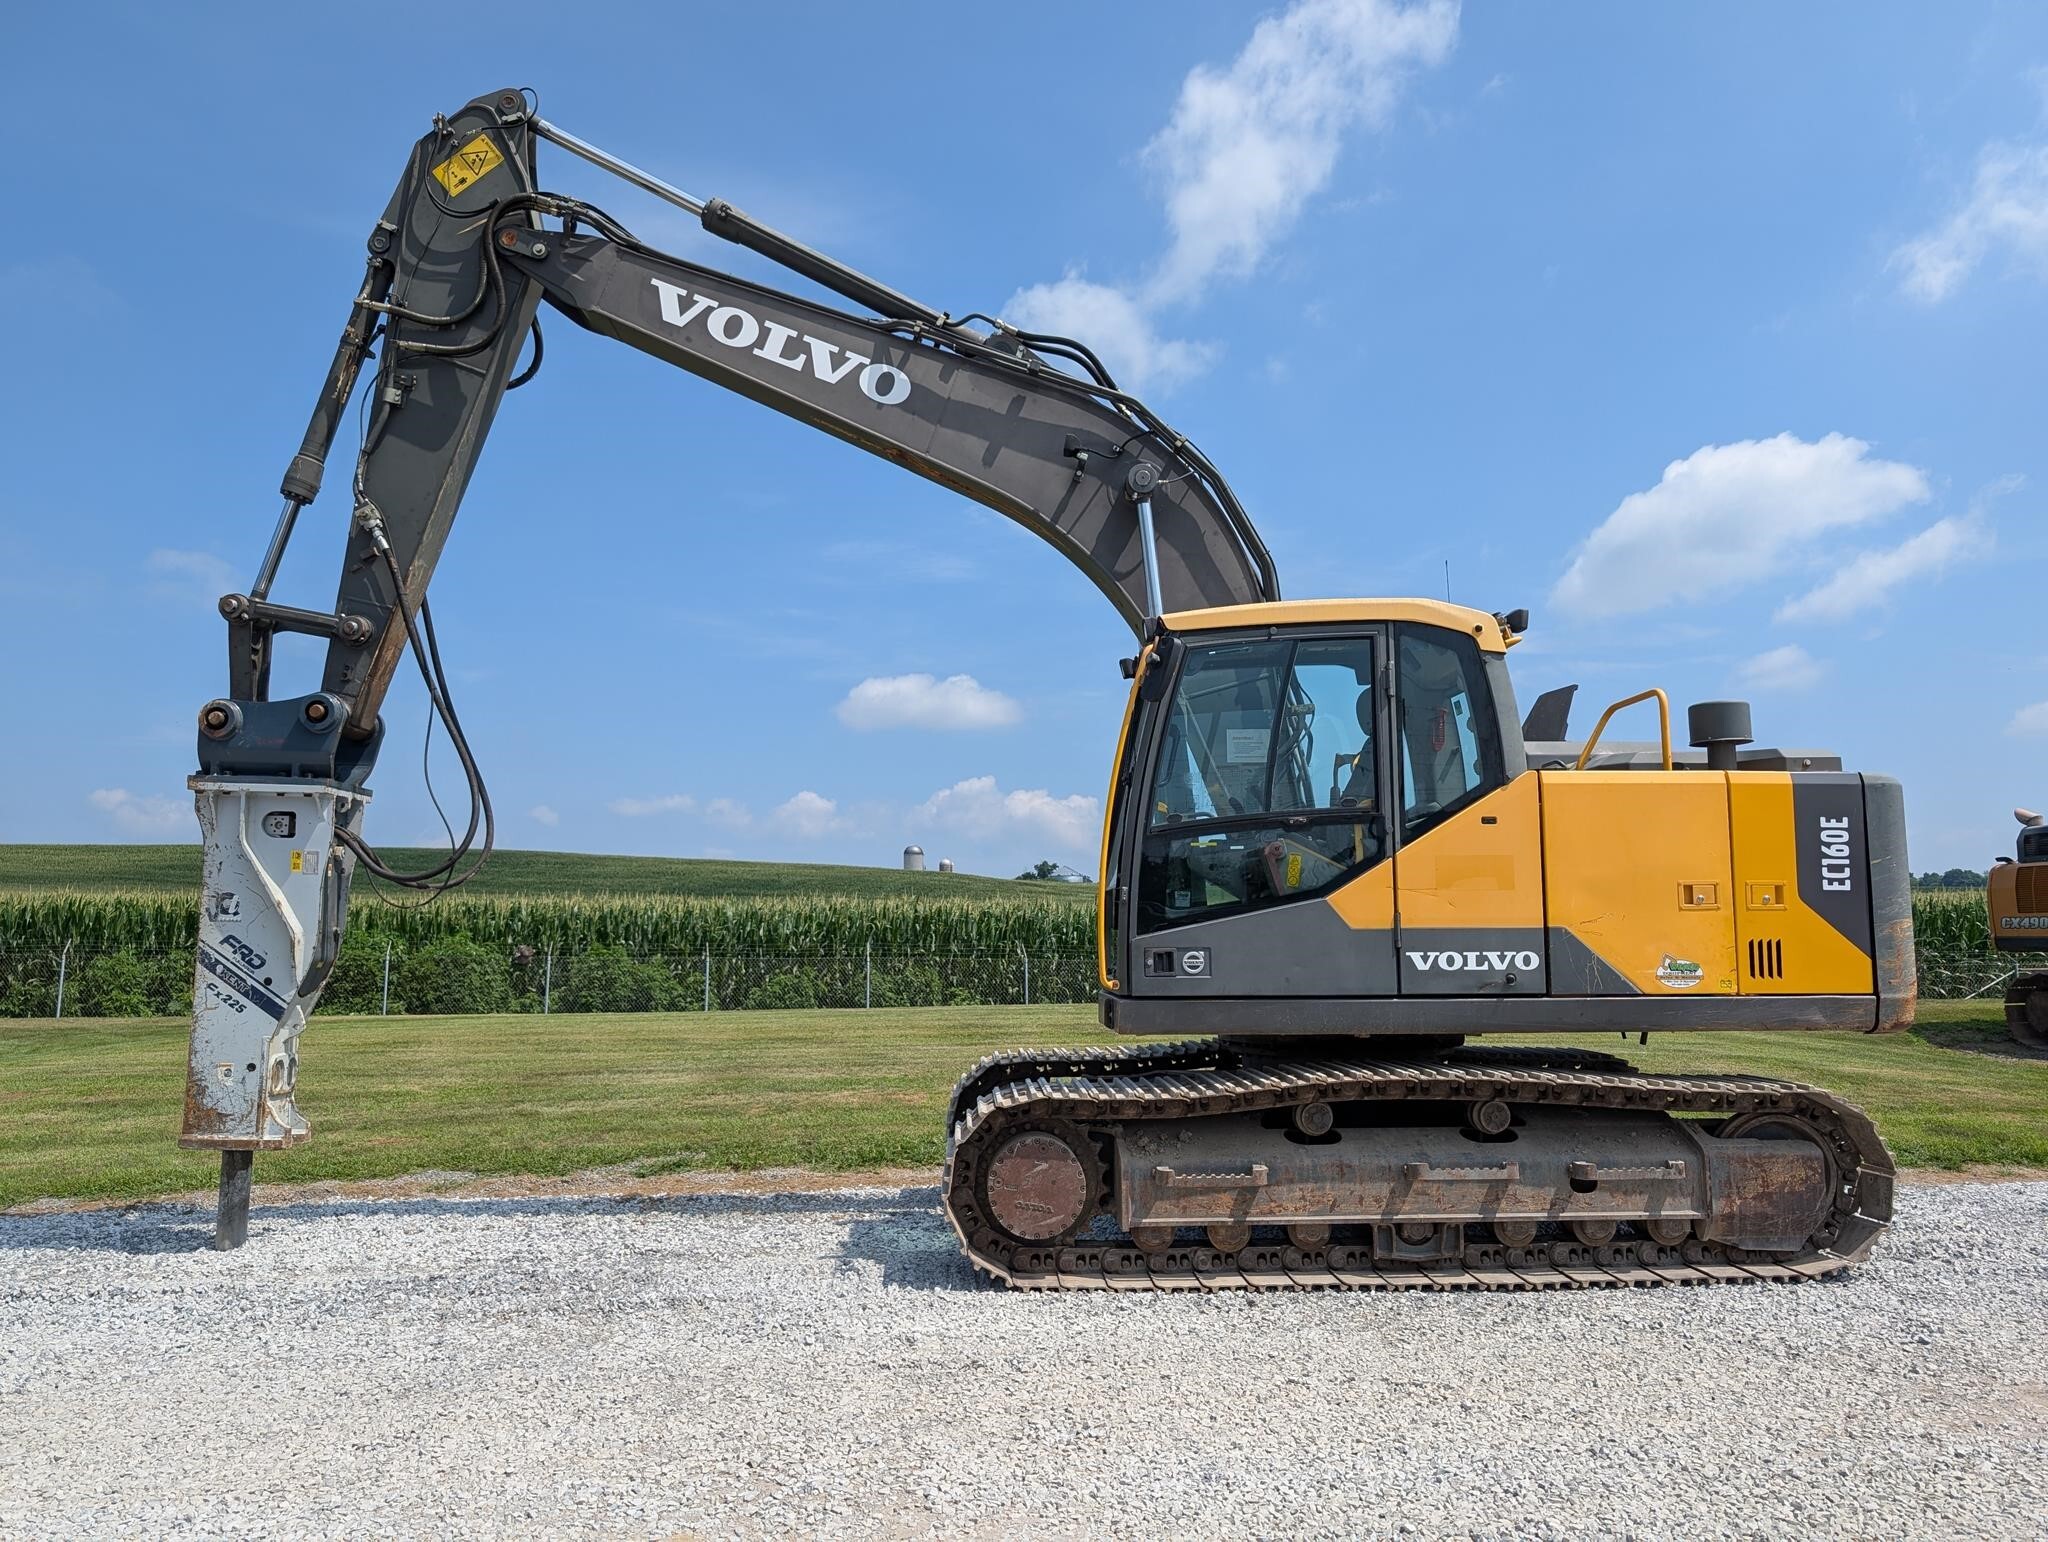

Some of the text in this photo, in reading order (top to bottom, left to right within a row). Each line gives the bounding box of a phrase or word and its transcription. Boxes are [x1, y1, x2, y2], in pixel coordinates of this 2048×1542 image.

[650, 277, 911, 405] VOLVO
[1820, 816, 1851, 891] EC160E
[2000, 916, 2048, 929] CX490
[218, 934, 267, 970] FRD
[1406, 951, 1540, 971] VOLVO
